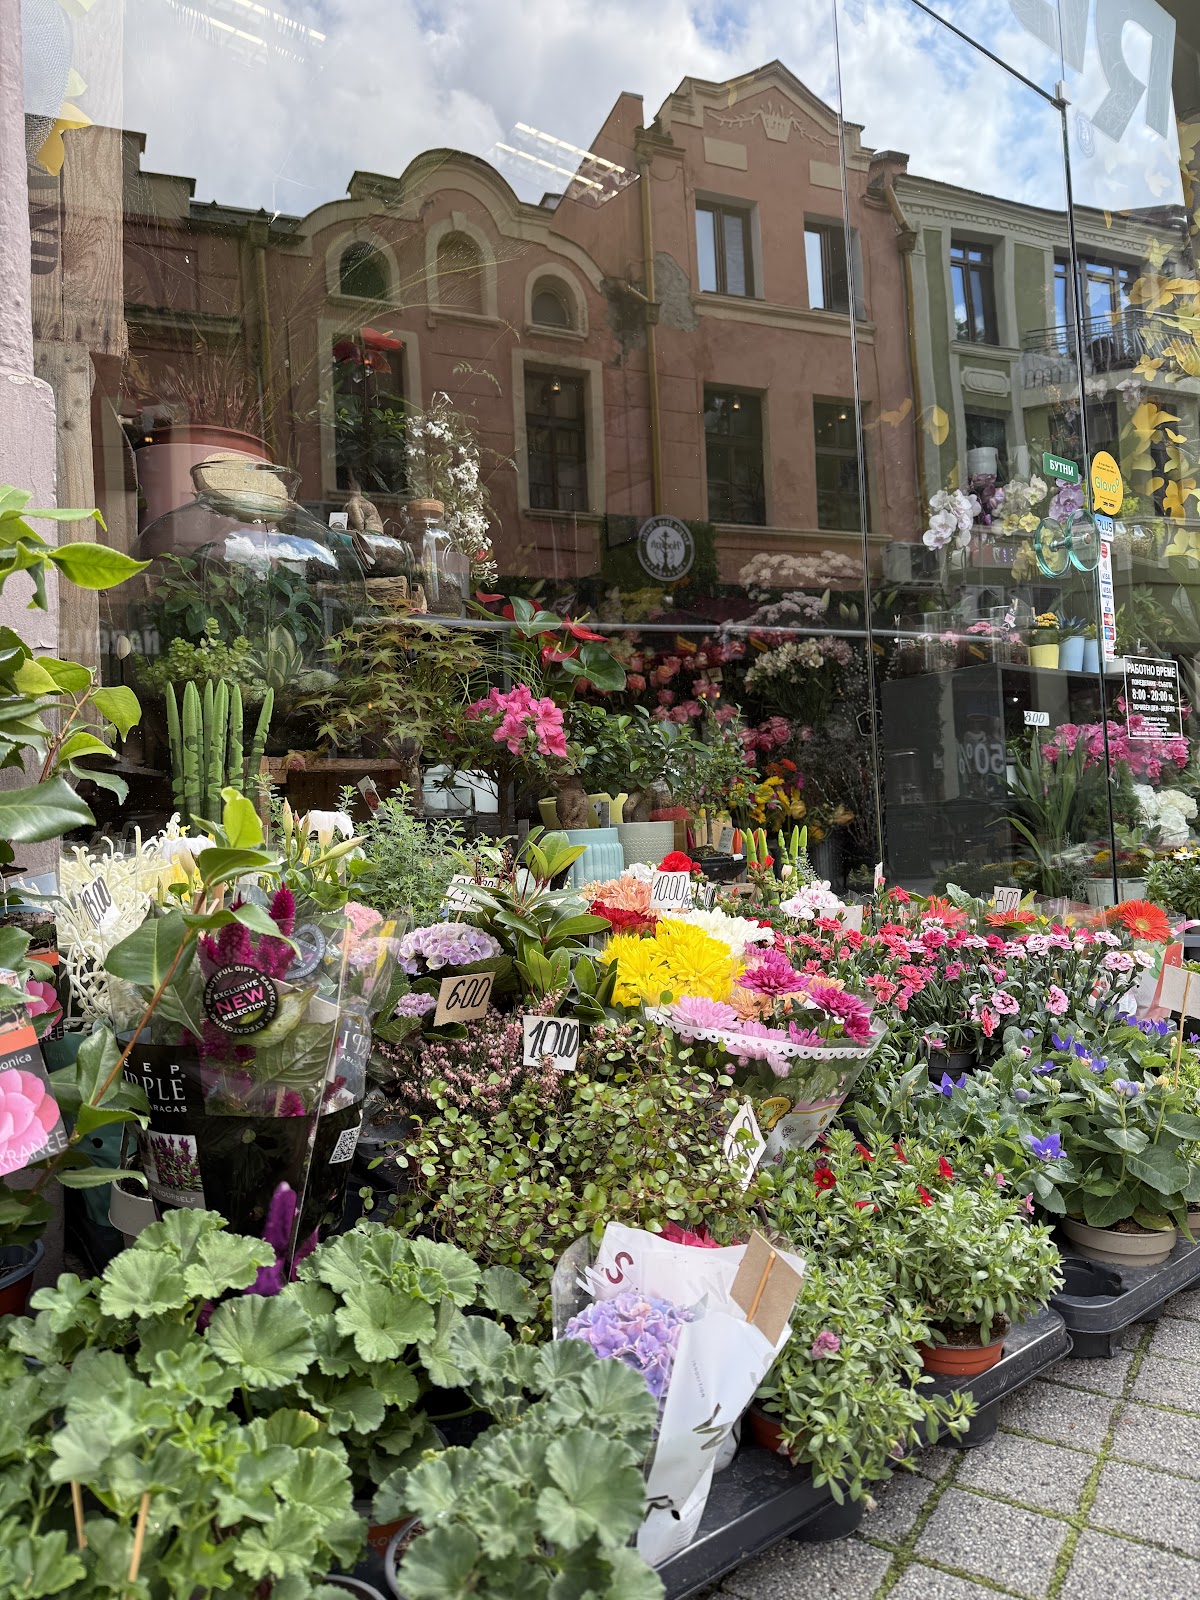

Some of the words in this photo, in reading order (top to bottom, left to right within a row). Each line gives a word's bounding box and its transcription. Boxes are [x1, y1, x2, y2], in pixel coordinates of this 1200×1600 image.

[1049, 459, 1074, 476] БУТНИ
[1094, 476, 1119, 494] Glovo
[1127, 663, 1155, 675] РАБОТНО
[1156, 666, 1176, 678] ВРЕМЕ
[1132, 689, 1146, 700] 8:00
[1151, 691, 1167, 701] 20:00
[234, 965, 254, 974] GIFT
[205, 967, 233, 1005] BEAUTIFUL
[213, 979, 259, 1000] EXCLUSIVE
[215, 986, 264, 1015] NEW
[259, 975, 276, 1018] EASYCARE
[222, 1000, 268, 1021] SELECTION
[210, 1013, 265, 1034] EYECATCHING
[0, 1053, 32, 1070] onica
[150, 1104, 188, 1113] RACAS
[157, 1188, 196, 1204] YOURSELF
